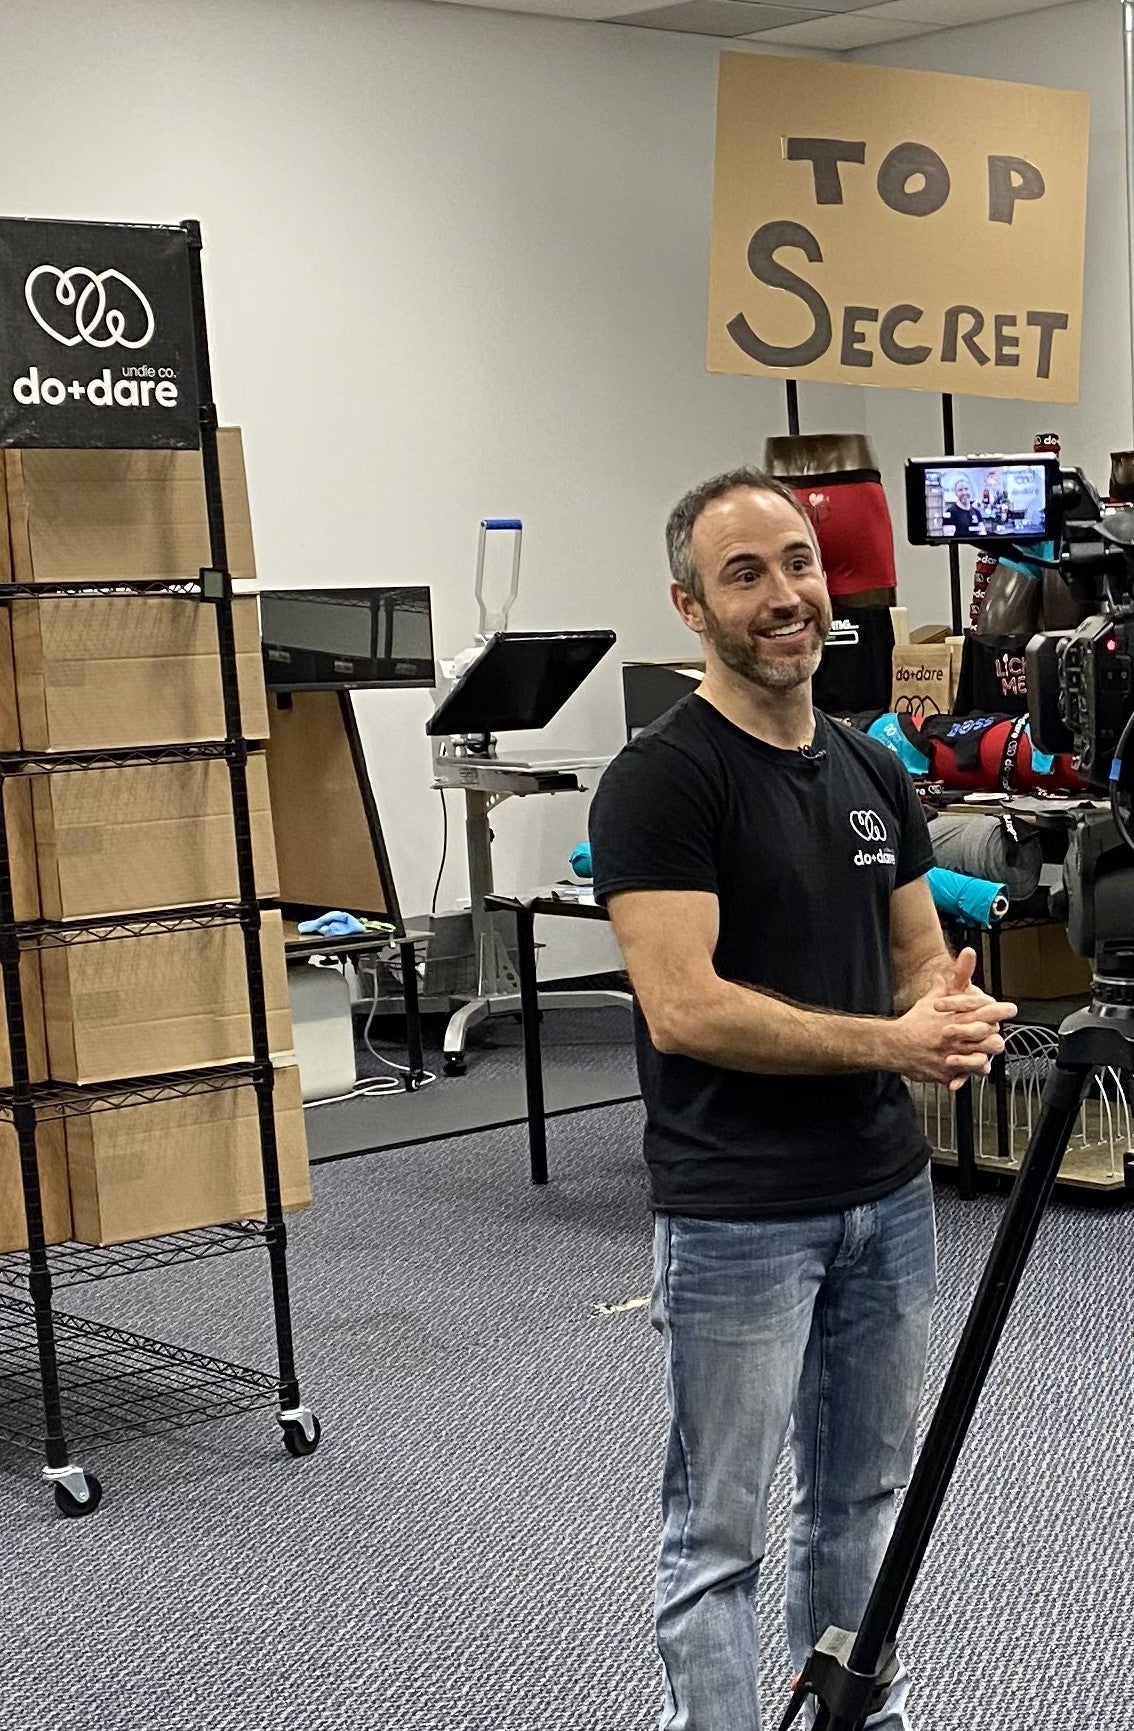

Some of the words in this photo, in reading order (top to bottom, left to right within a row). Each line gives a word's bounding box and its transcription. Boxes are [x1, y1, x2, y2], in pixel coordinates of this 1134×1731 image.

[787, 137, 1046, 225] TOP
[122, 365, 156, 377] undie
[157, 367, 178, 378] co.
[12, 366, 179, 408] do+dare
[896, 665, 943, 681] do+dare
[1002, 675, 1028, 696] ME
[854, 849, 896, 865] do+dare
